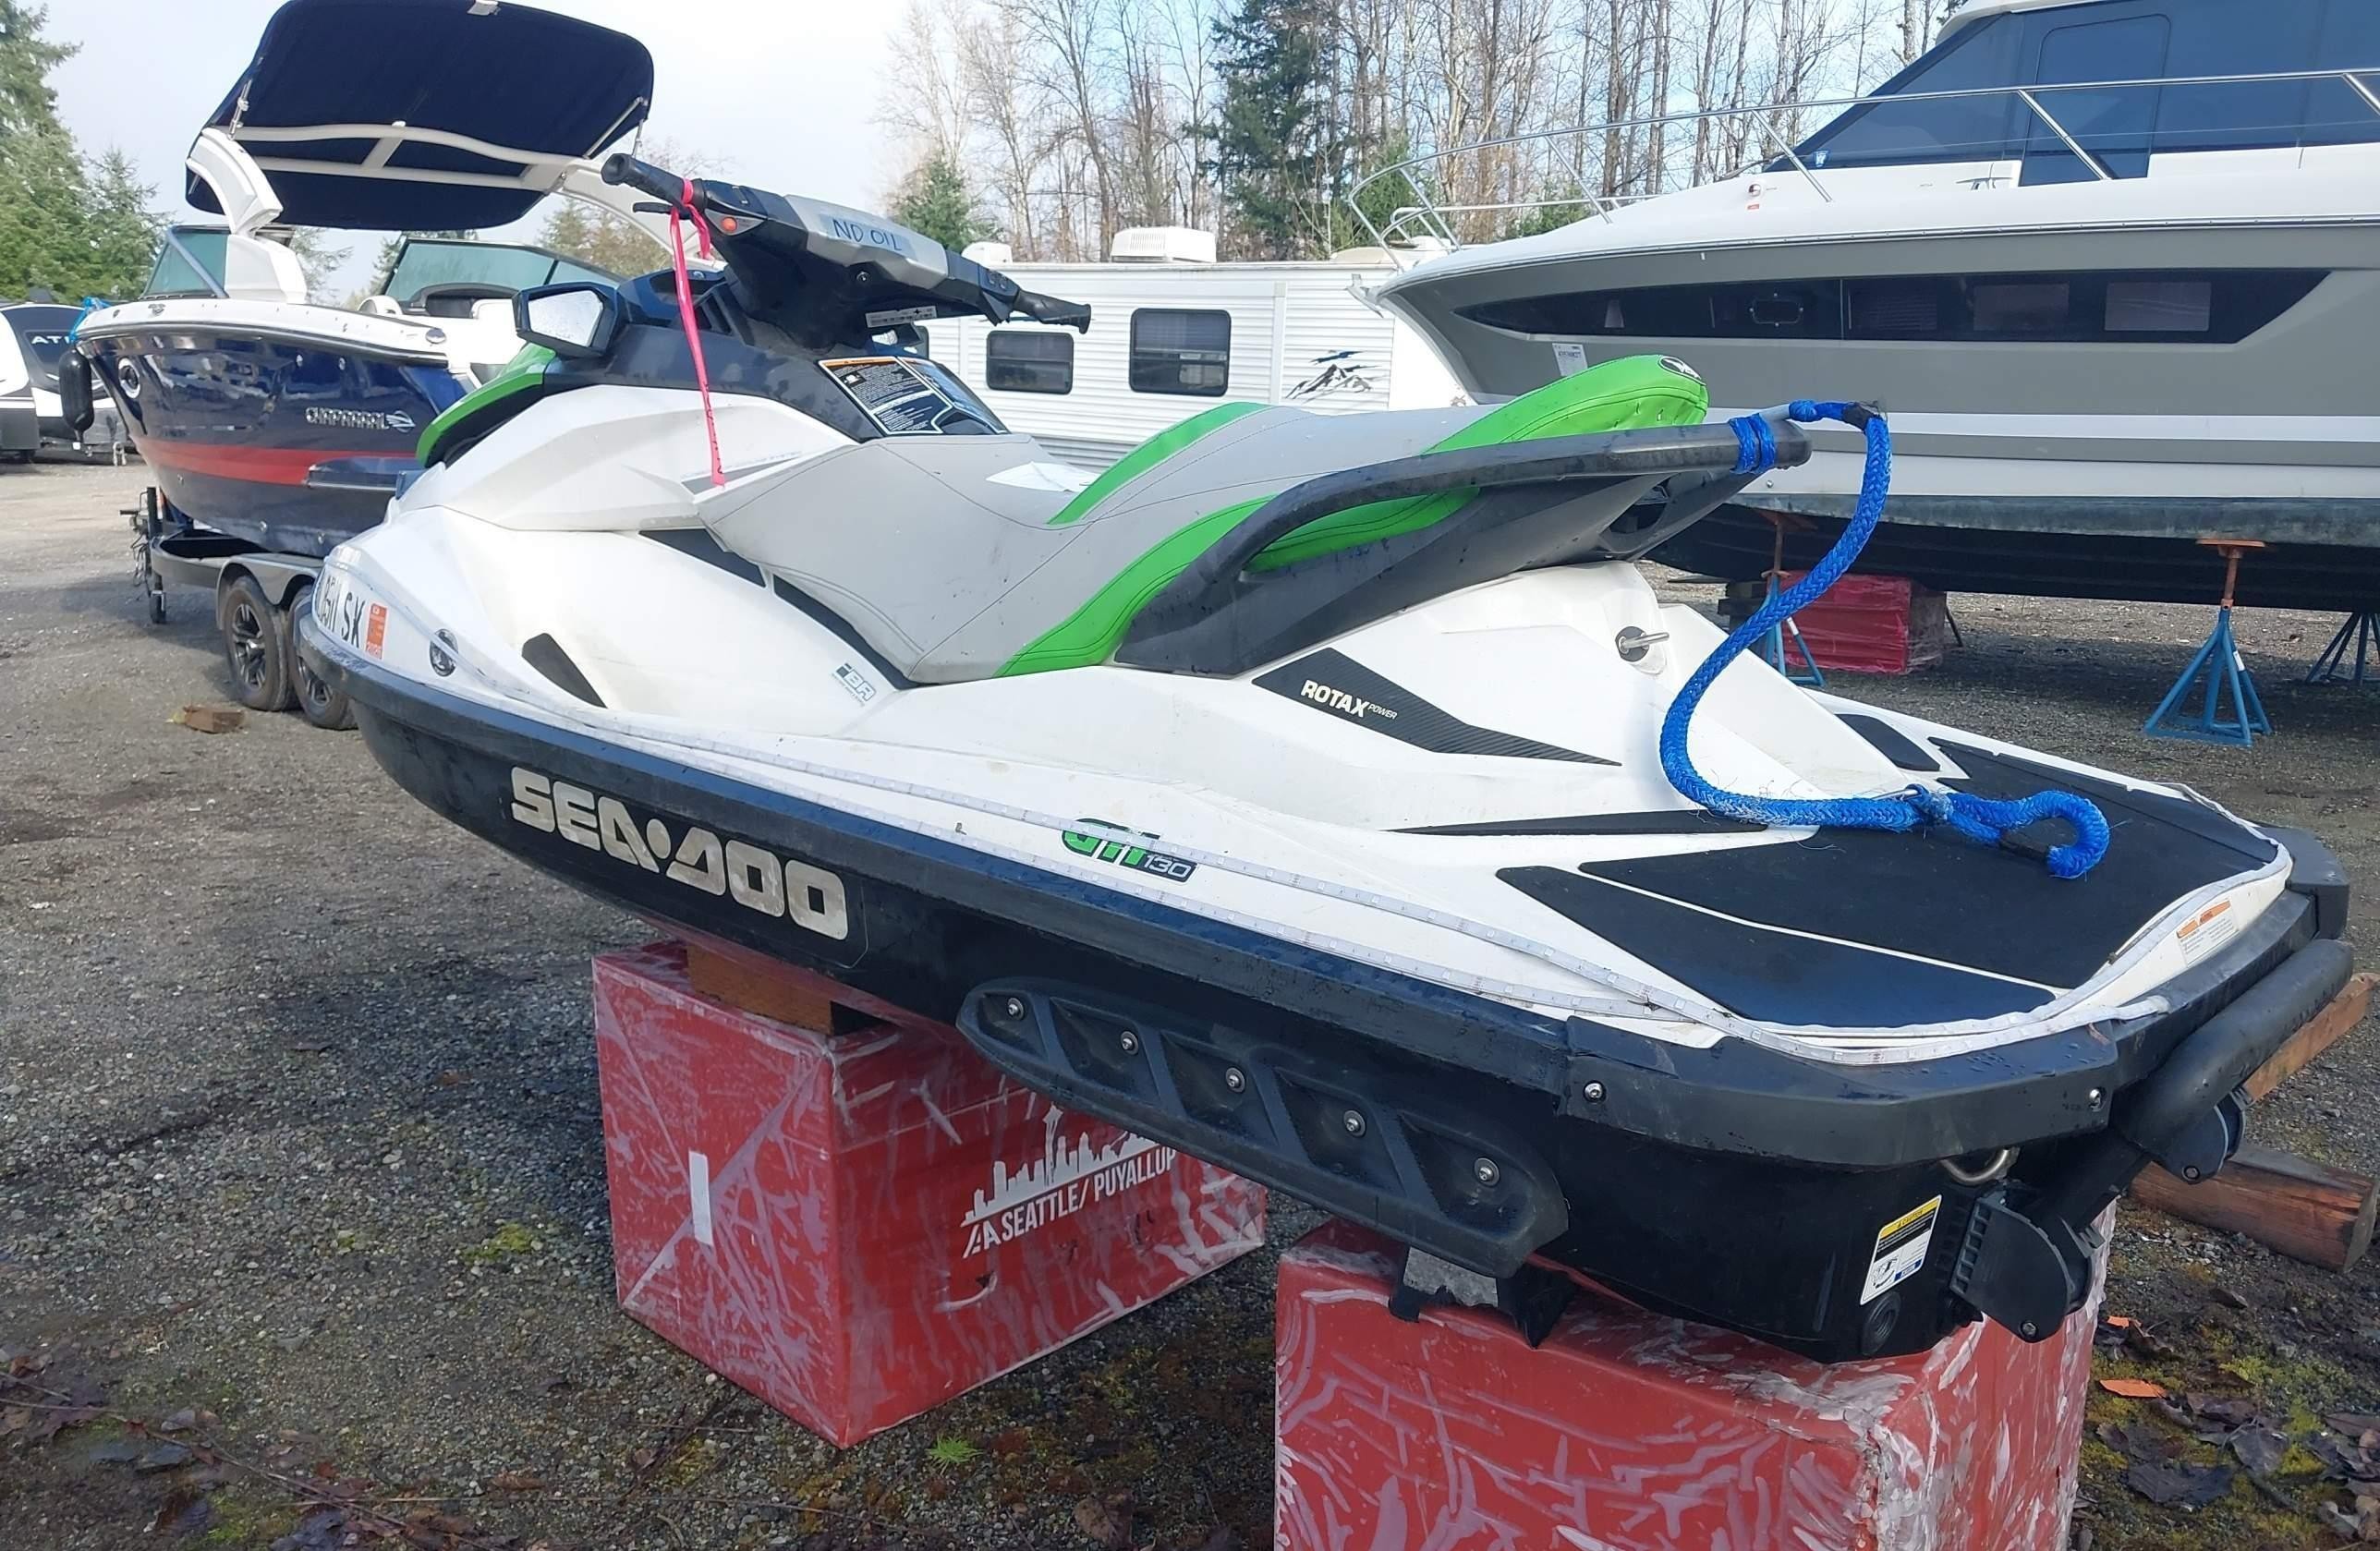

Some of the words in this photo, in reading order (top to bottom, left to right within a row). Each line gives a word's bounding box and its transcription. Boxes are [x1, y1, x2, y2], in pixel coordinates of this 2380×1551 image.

[870, 229, 902, 251] OIL
[1300, 679, 1370, 718] ROTAX
[1367, 703, 1398, 720] POWER
[1143, 854, 1193, 878] 130
[1094, 1146, 1177, 1202] PUYALLUP
